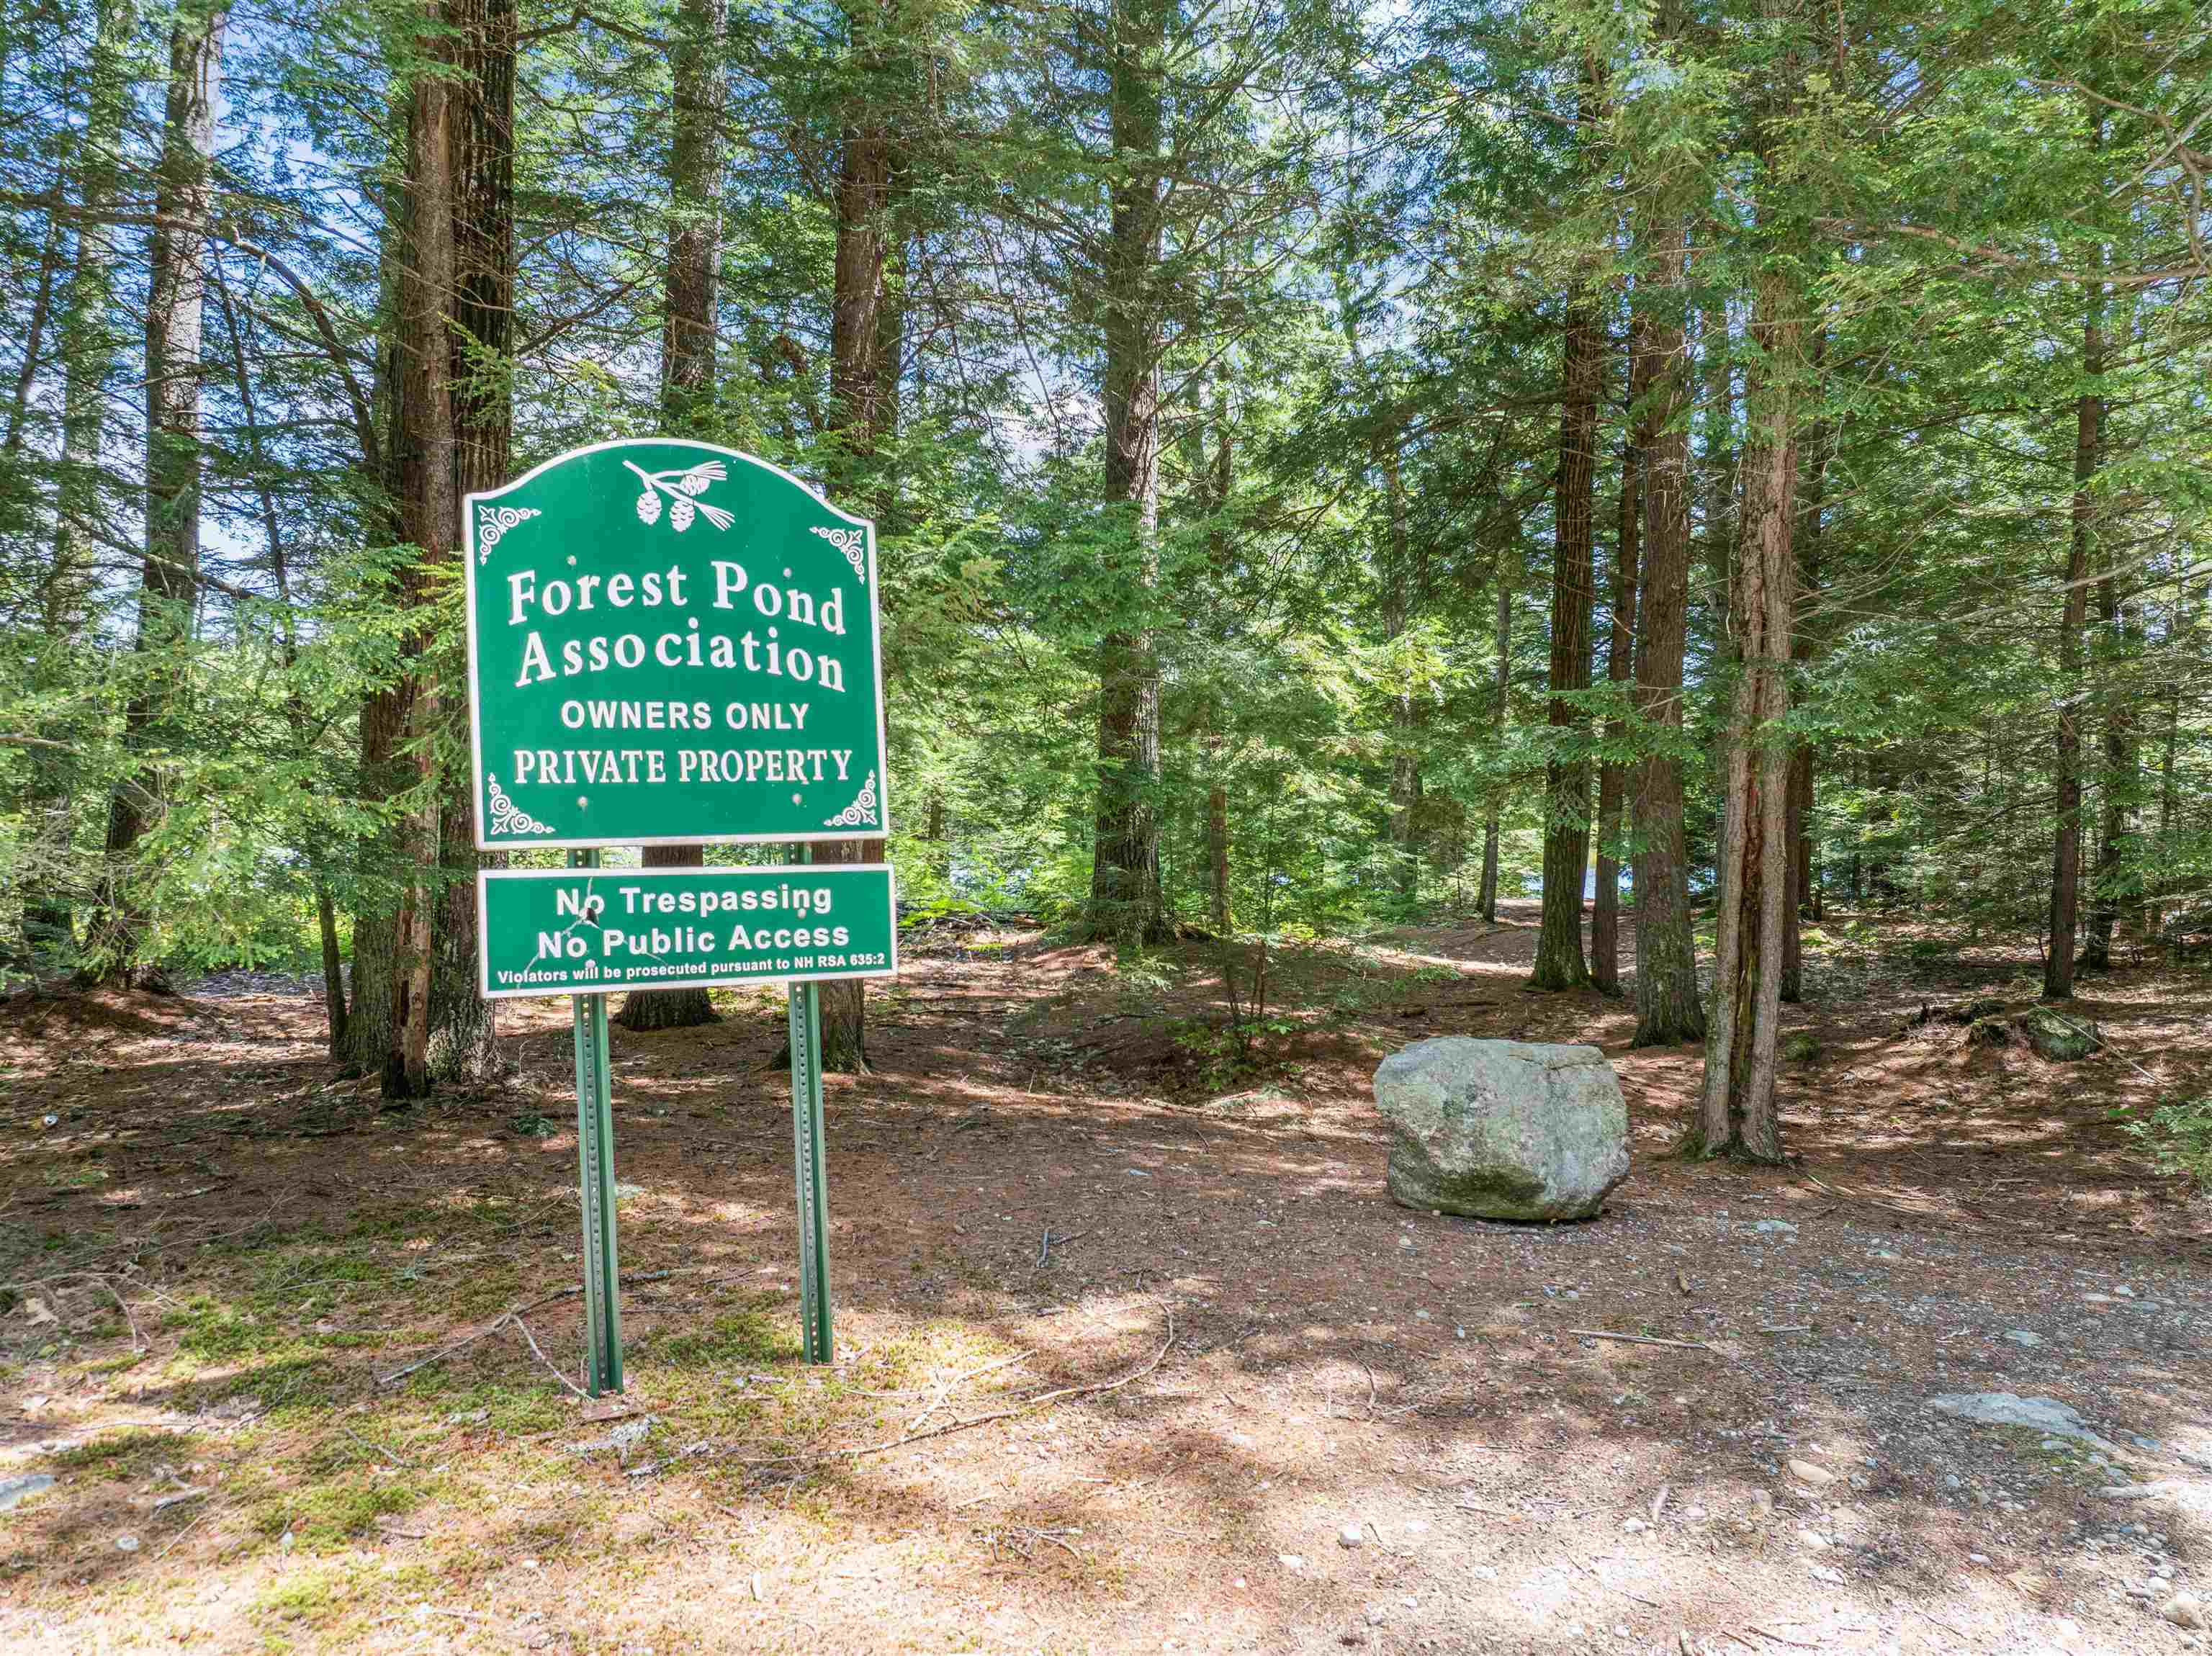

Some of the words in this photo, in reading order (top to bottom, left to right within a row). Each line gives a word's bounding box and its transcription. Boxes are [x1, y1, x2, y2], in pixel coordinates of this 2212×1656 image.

[508, 564, 688, 626] Forest
[711, 561, 847, 636] Pond
[515, 617, 846, 692] Association
[561, 700, 711, 729] OWNERS
[726, 703, 809, 730] ONLY
[514, 750, 666, 784] PRIVATE
[678, 750, 853, 783] PROPERTY
[556, 888, 606, 917] No
[619, 884, 832, 917] Trespassing
[537, 932, 588, 959] No
[603, 927, 716, 956] Public
[728, 924, 850, 950] Access
[498, 968, 568, 984] Violators
[572, 966, 599, 980] will
[603, 965, 621, 979] be
[626, 961, 706, 979] prosecuted
[711, 958, 772, 974] pursuant
[775, 958, 791, 971] to
[794, 956, 814, 968] NH
[817, 955, 846, 967] RSA
[850, 953, 885, 966] 635:2
